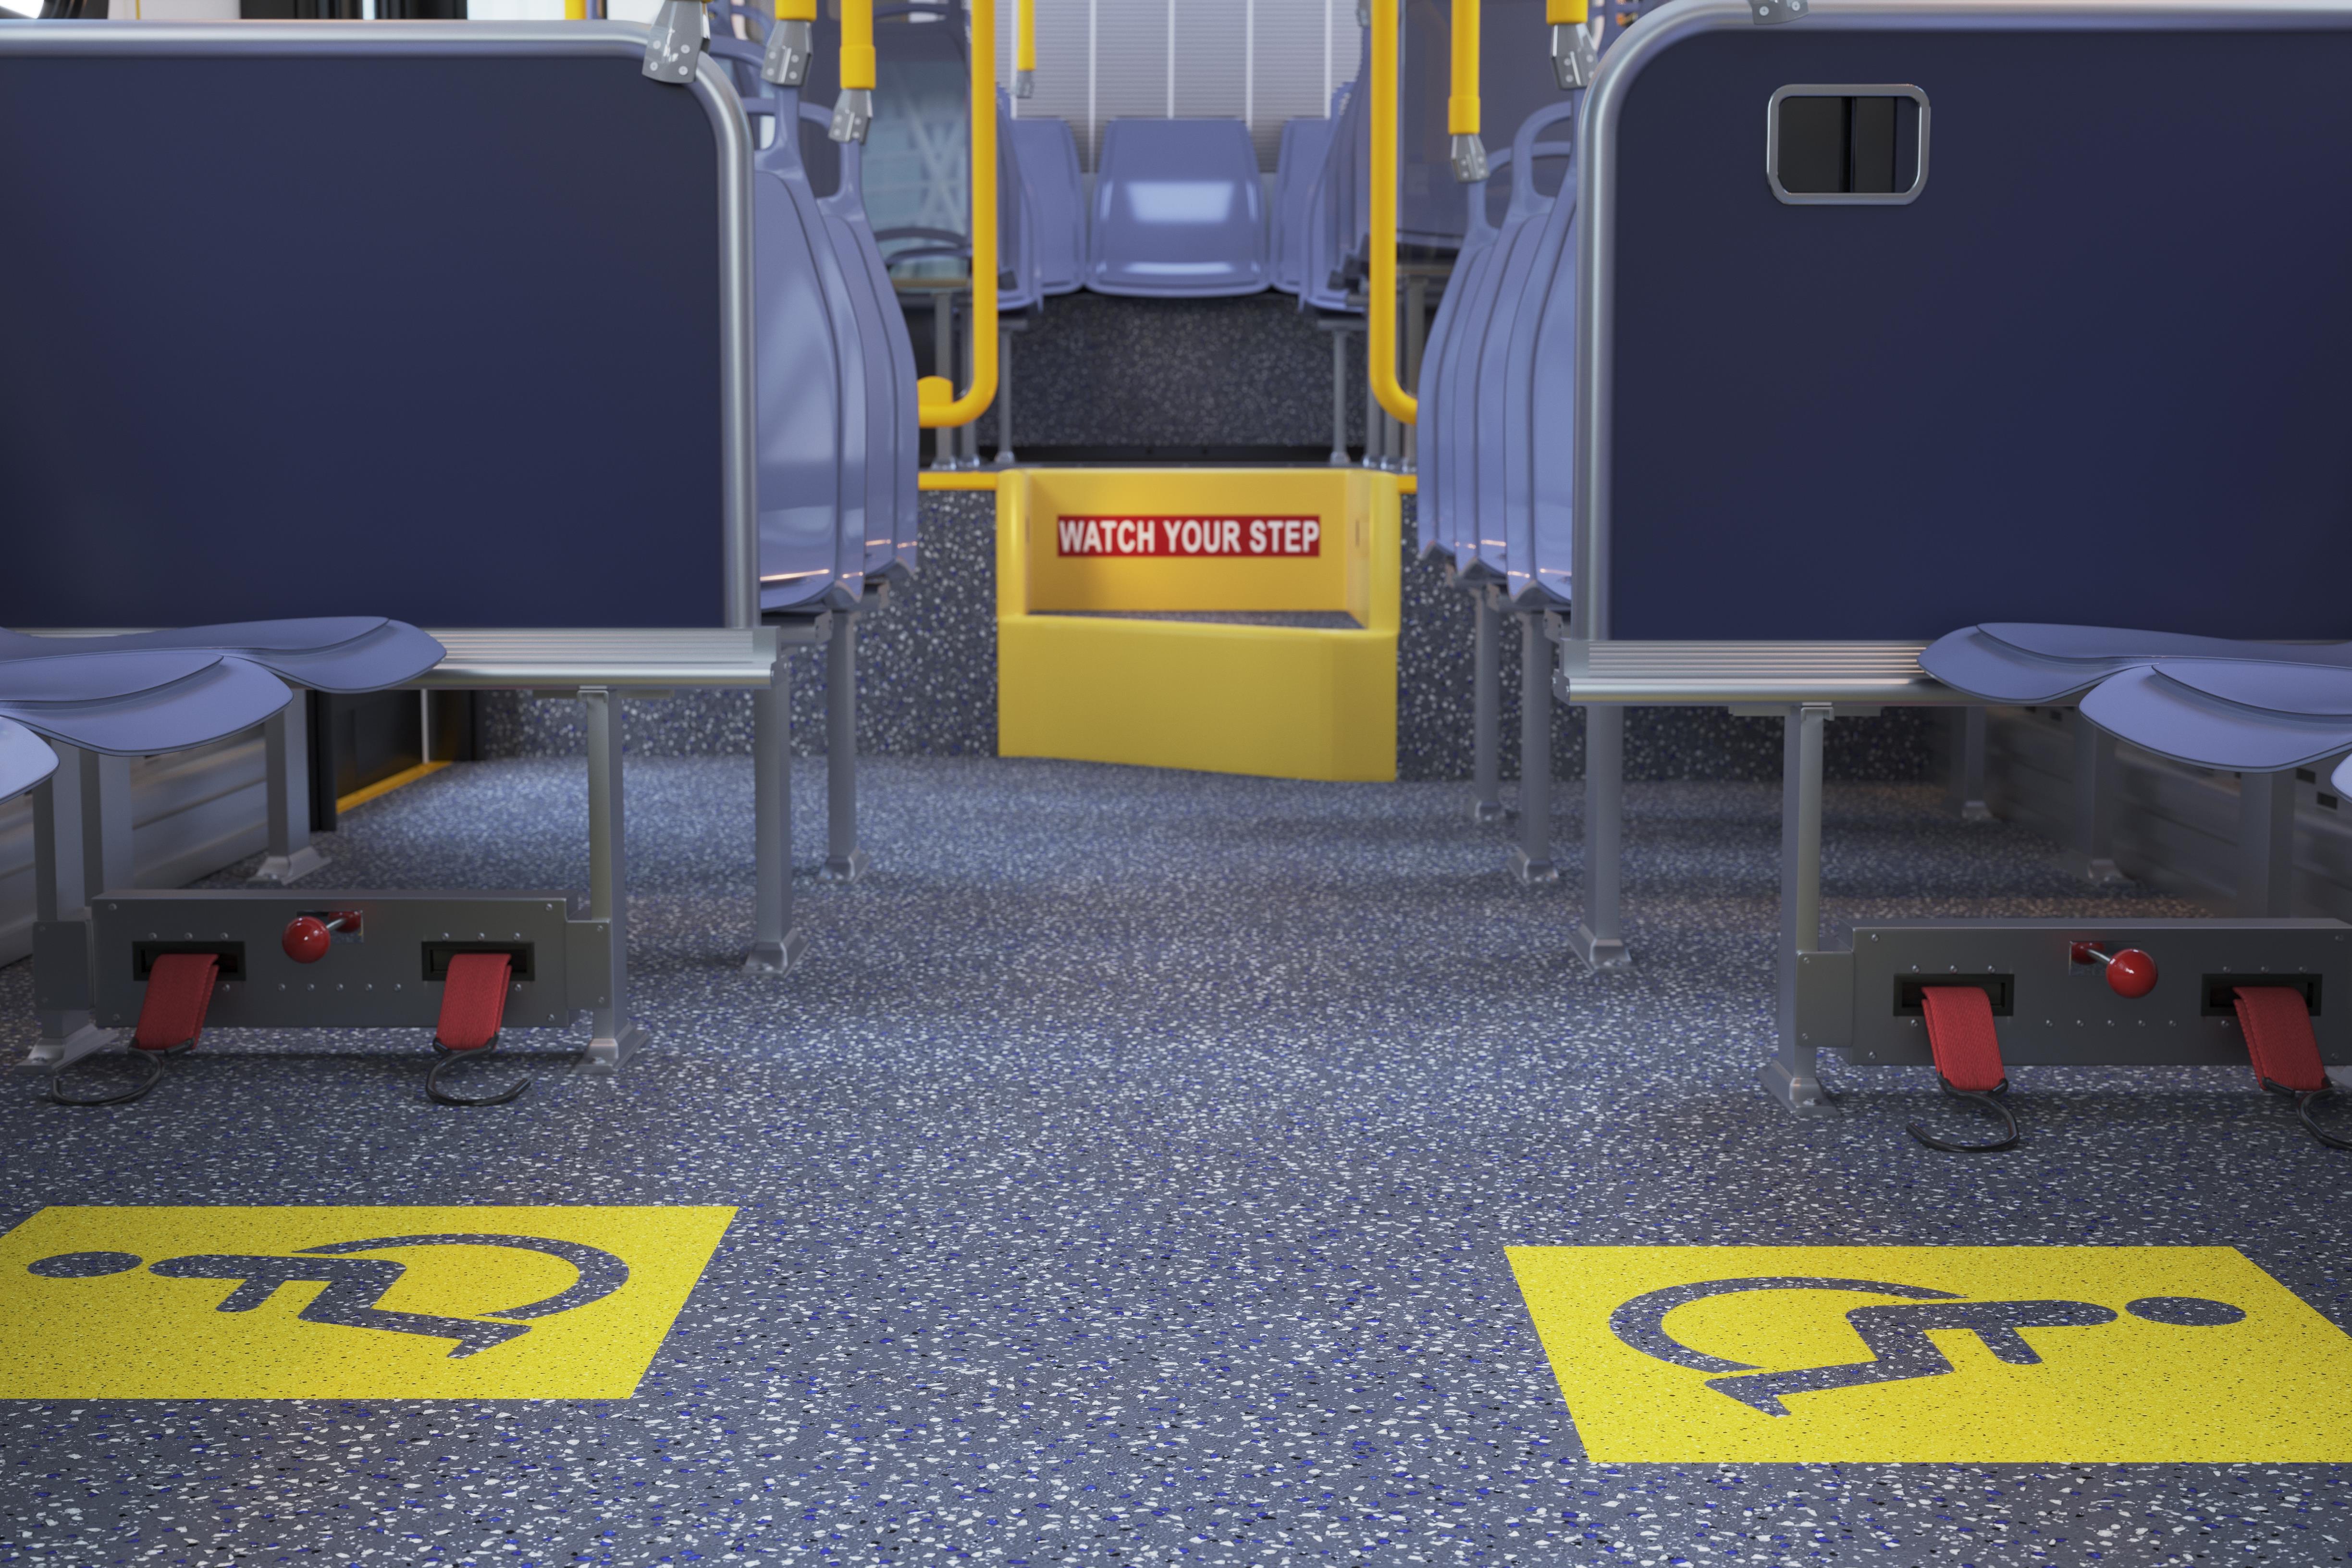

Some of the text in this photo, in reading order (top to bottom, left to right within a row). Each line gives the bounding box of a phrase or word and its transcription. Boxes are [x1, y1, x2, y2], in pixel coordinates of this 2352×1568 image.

[1059, 519, 1320, 553] WATCH YOUR STEP
